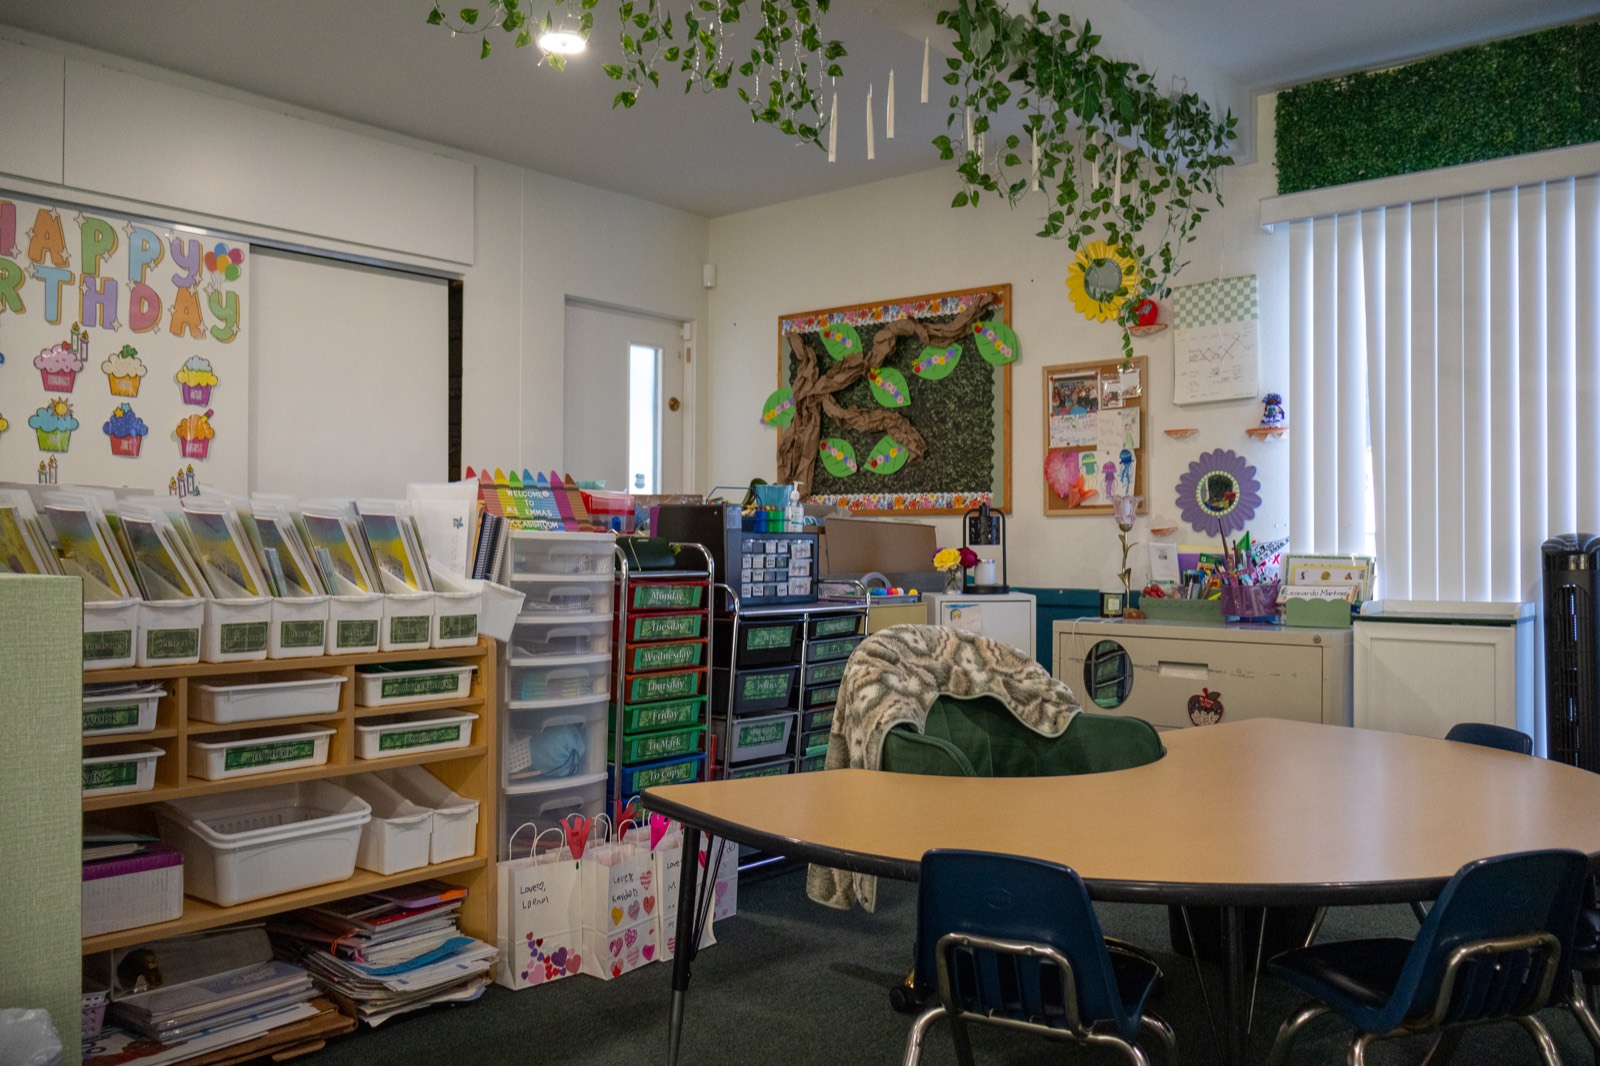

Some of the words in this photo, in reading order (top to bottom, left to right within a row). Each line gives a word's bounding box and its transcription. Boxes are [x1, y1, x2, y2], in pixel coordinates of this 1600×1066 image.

[506, 489, 542, 499] WELCOME
[525, 499, 534, 508] TO
[510, 518, 559, 529] CLASSROOM
[651, 590, 684, 602] Monday
[1285, 589, 1319, 597] Leonardo
[652, 621, 684, 633] Tuesday
[643, 650, 691, 663] Wednesday
[646, 680, 685, 692] Thursday
[652, 709, 679, 722] Friday
[648, 742, 659, 751] To
[661, 738, 681, 749] Mark
[263, 748, 295, 759] CHECK
[650, 772, 660, 781] To
[661, 768, 681, 780] Copy
